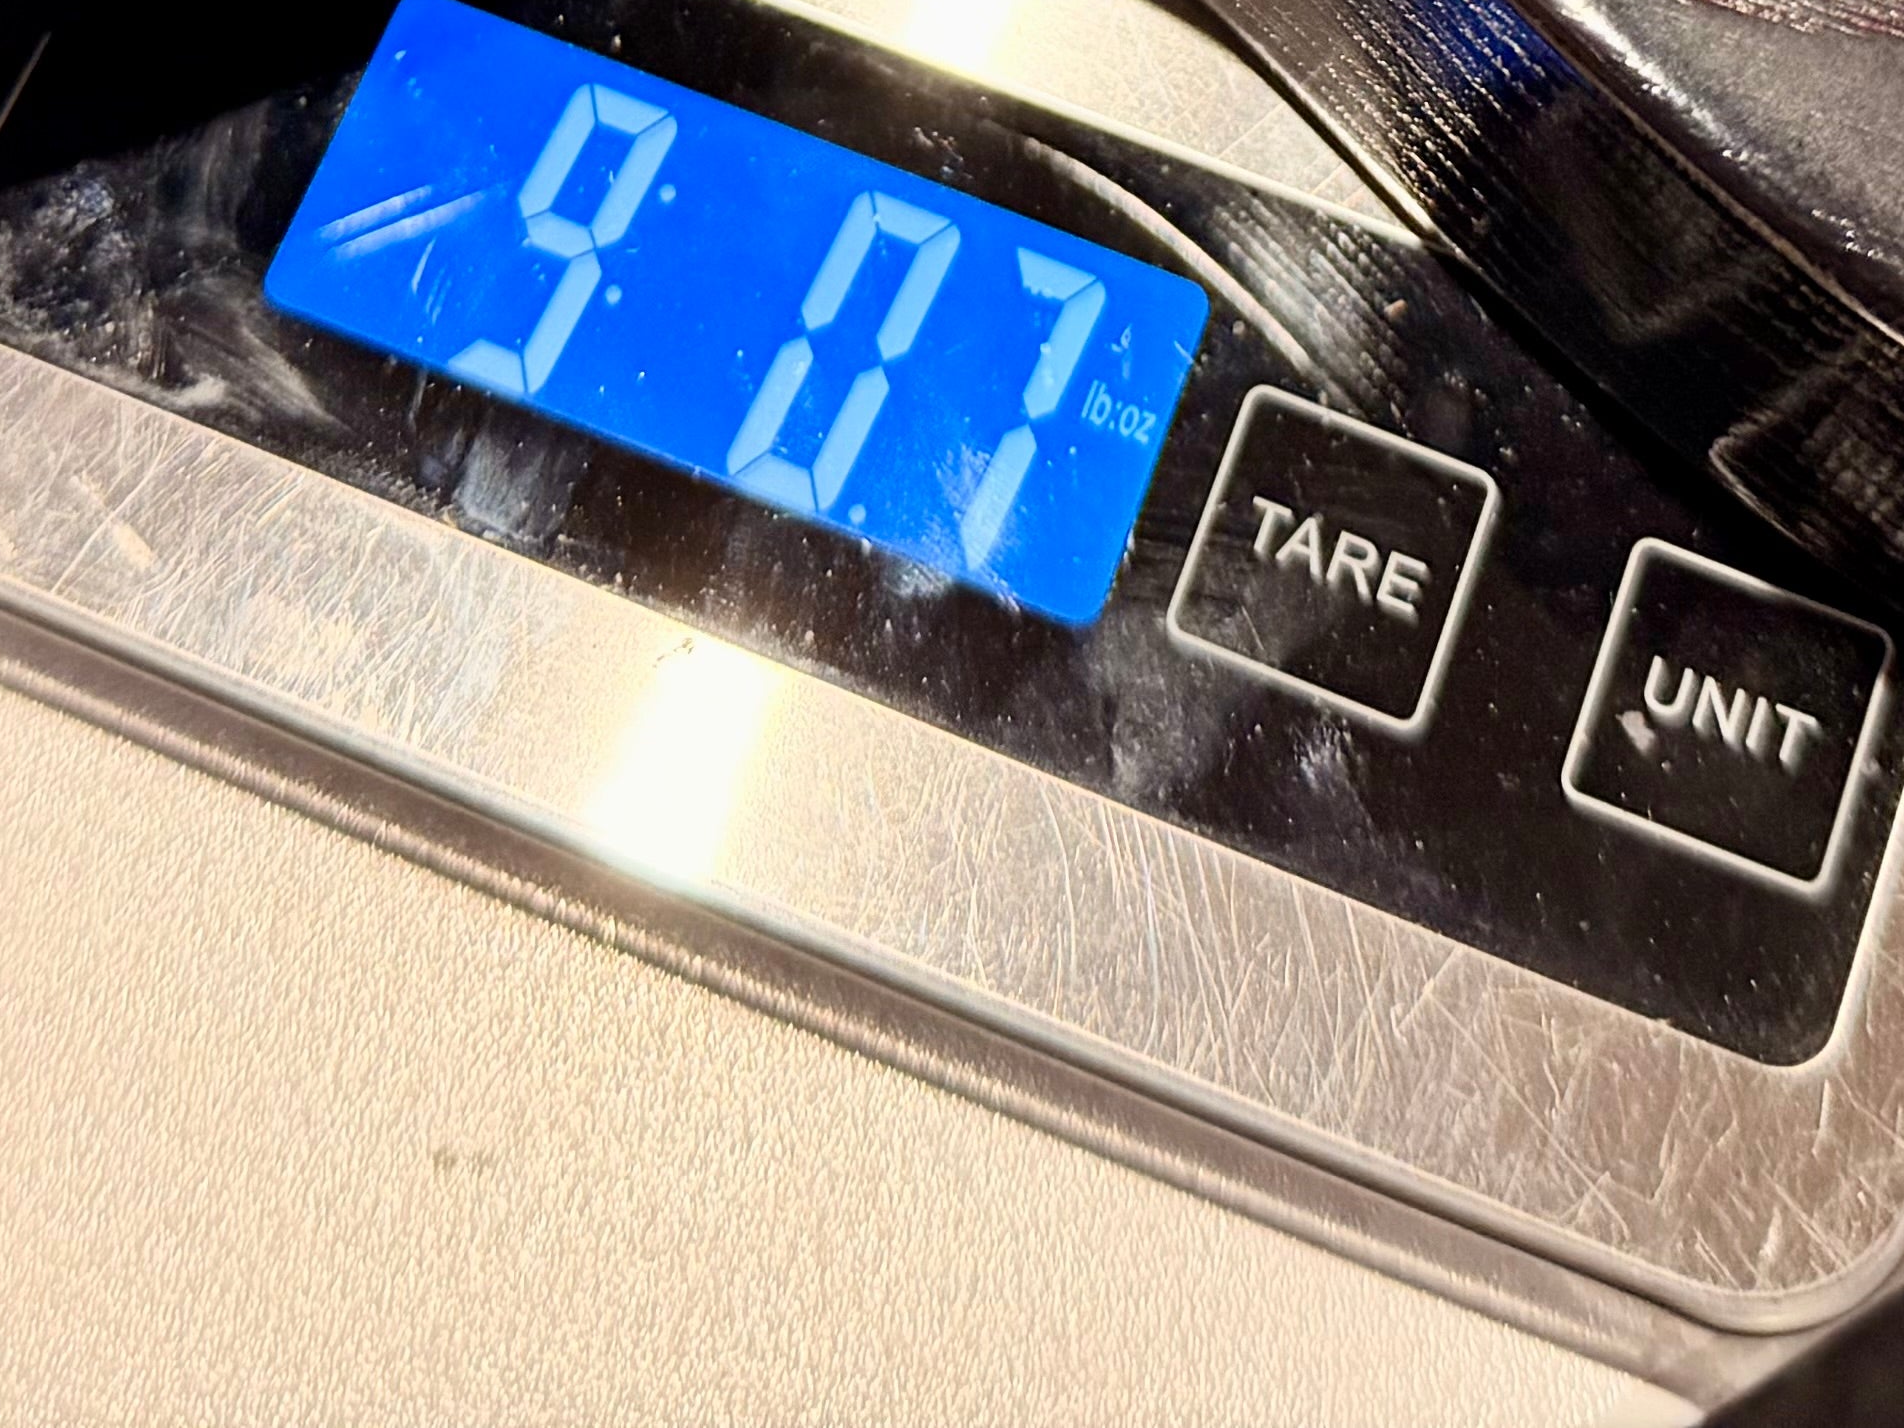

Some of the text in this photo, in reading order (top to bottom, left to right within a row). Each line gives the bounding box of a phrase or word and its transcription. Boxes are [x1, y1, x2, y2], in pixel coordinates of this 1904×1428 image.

[1081, 379, 1156, 445] lb:oz
[1250, 495, 1431, 622] TARE
[1643, 656, 1820, 770] UNIT
